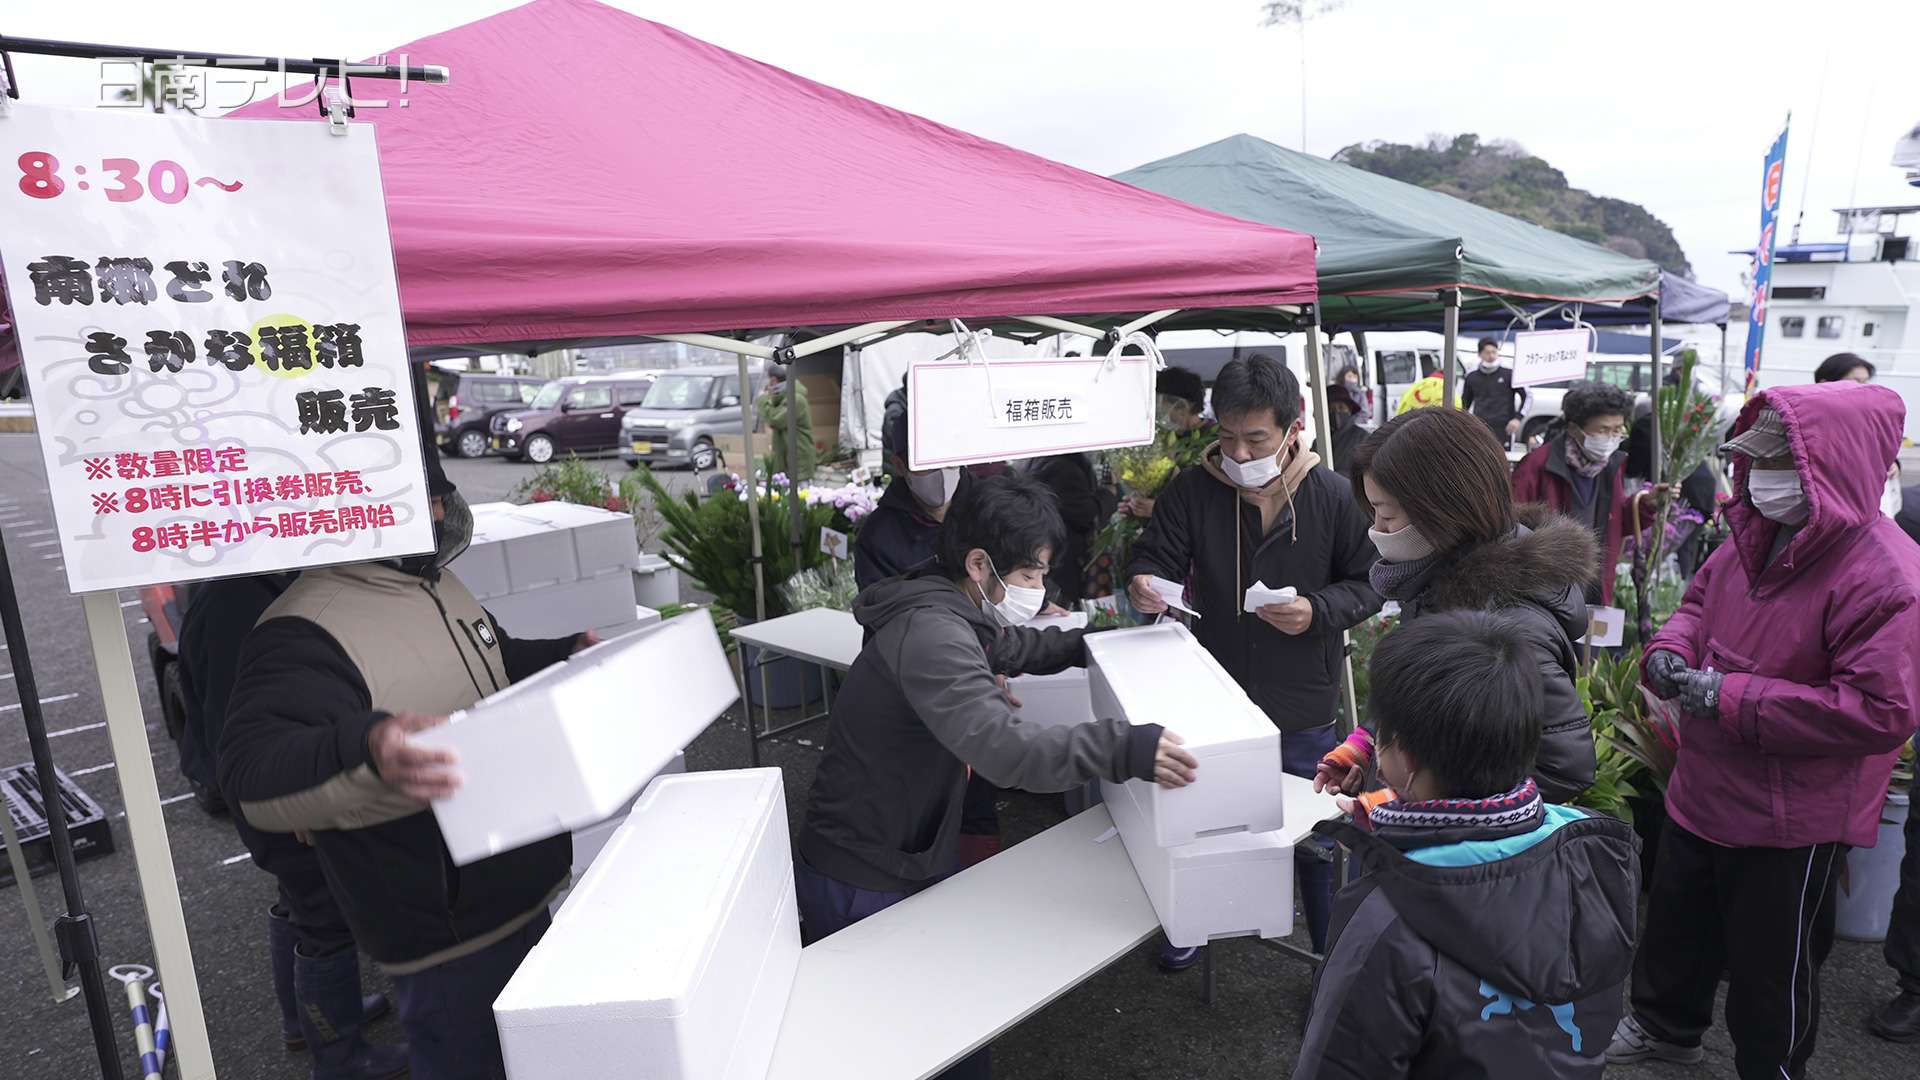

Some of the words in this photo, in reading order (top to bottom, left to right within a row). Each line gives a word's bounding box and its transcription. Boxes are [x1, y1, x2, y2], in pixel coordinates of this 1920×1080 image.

[26, 255, 272, 306] 南郷どれ
[85, 323, 364, 375] さかな福箱
[295, 387, 401, 435] 販売
[1005, 397, 1073, 422] 福箱販売
[131, 503, 396, 553] 8時半から販売開始
